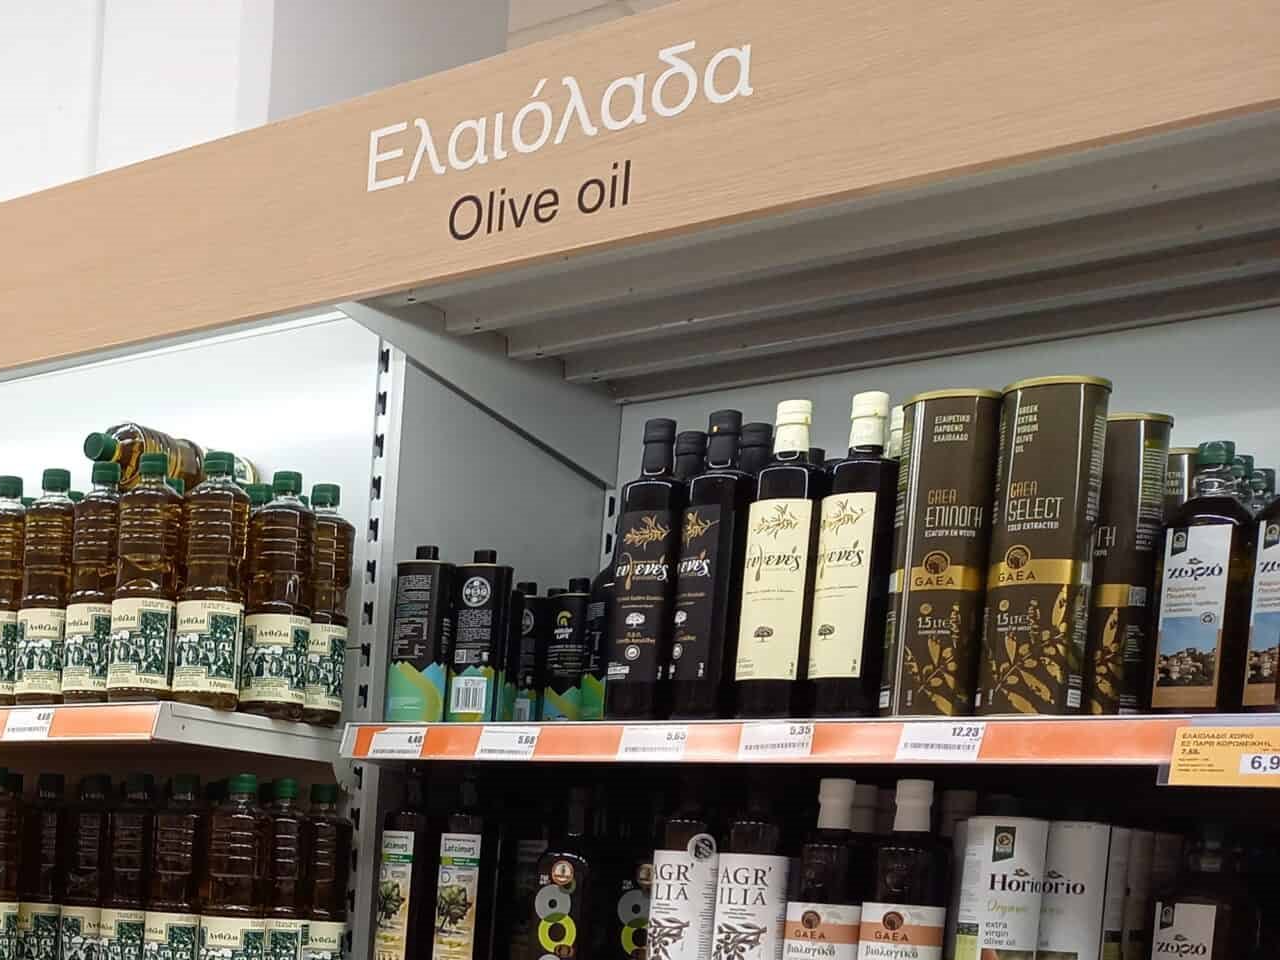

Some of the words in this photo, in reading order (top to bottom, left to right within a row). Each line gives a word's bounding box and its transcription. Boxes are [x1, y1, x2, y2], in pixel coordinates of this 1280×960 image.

[367, 40, 754, 192] Ελαιόλαδα
[448, 187, 559, 241] Olive
[577, 159, 632, 214] oil
[1008, 497, 1064, 521] SELECT
[915, 576, 955, 587] GAEA
[999, 570, 1037, 582] GAEA
[951, 727, 979, 738] 12.23
[1042, 877, 1086, 895] orio
[985, 921, 1008, 930] extra
[794, 929, 827, 940] GAEA
[875, 930, 909, 942] GAEA
[985, 930, 1009, 939] virgin
[984, 937, 1005, 946] olive
